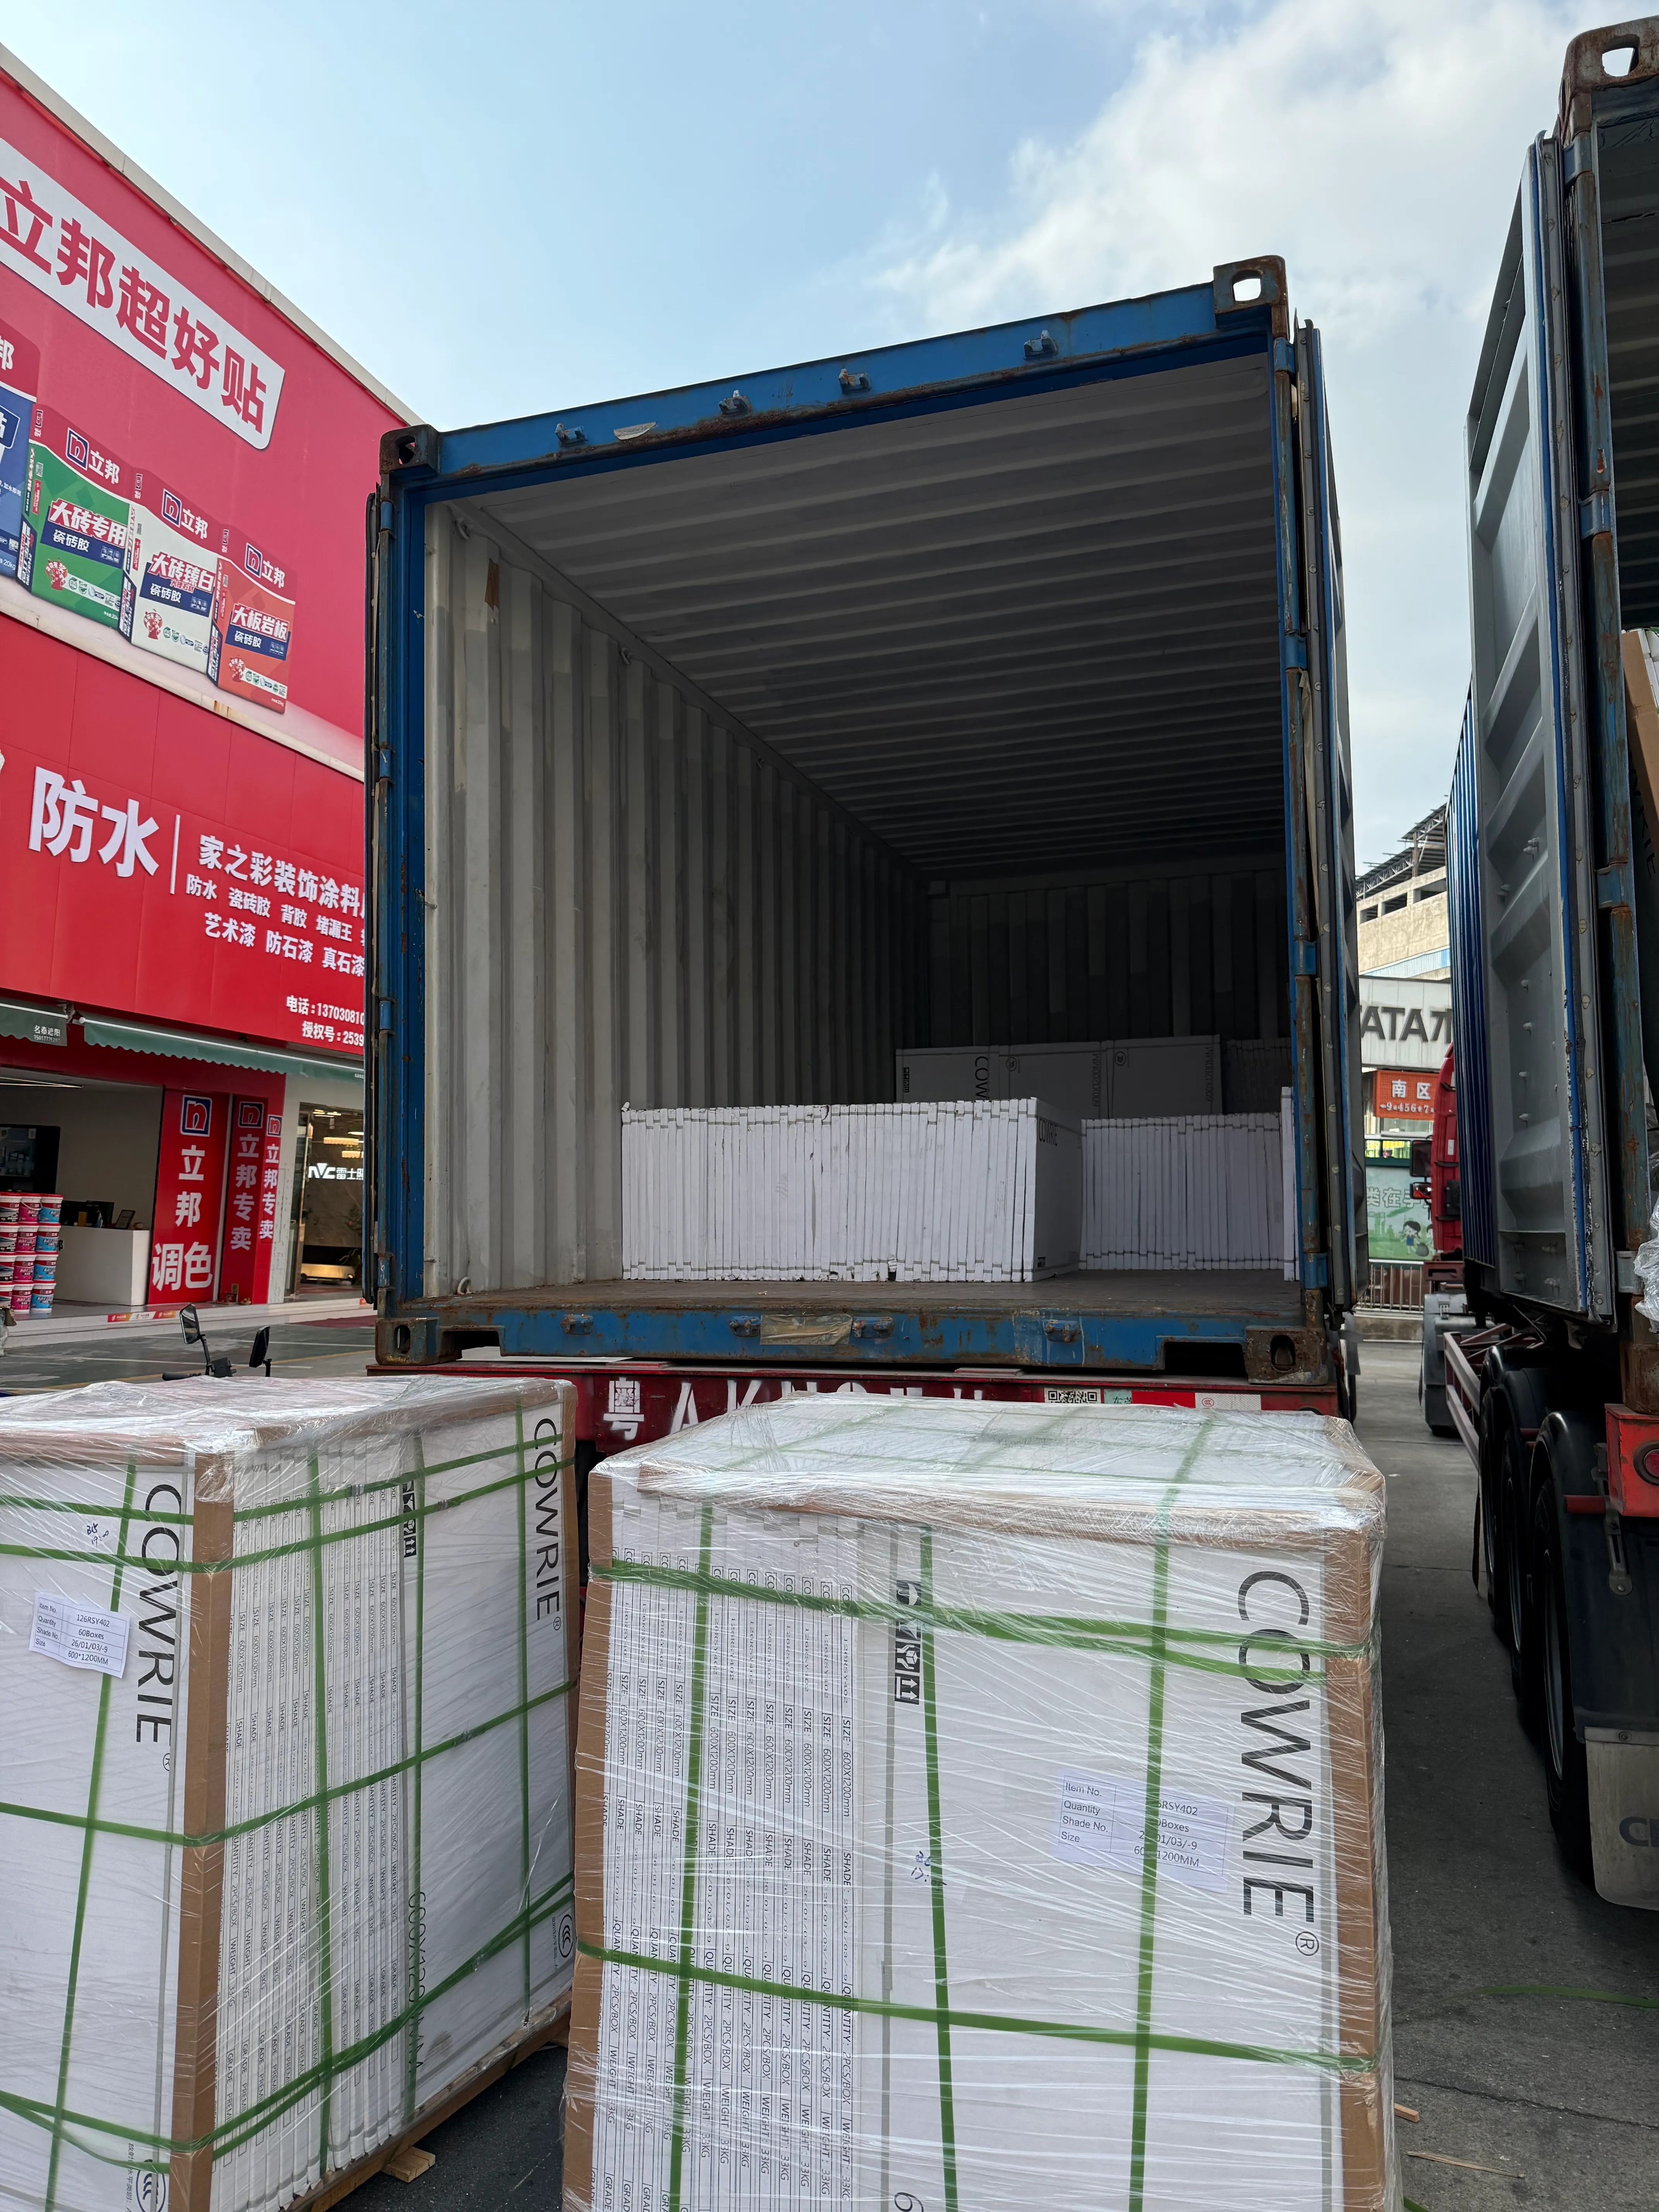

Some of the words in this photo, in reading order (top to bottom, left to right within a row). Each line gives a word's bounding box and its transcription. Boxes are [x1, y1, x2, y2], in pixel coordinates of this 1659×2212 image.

[0, 180, 266, 434] 立邦超好贴
[89, 449, 120, 484] 立邦
[50, 501, 125, 547] 大砖专用
[53, 529, 89, 552] 瓷砖胶
[181, 508, 208, 539] 立邦
[150, 583, 181, 603] 瓷砖胶
[151, 555, 214, 592] 大砖臻白
[261, 560, 285, 588] 立邦
[233, 606, 288, 641] 大板岩板
[234, 630, 262, 648] 瓷砖胶
[29, 766, 159, 878] 防水
[199, 835, 364, 919] 家之彩装饰涂料
[186, 874, 217, 900] 防水
[228, 887, 271, 917] 瓷砖胶
[281, 904, 307, 929] 背胶
[316, 915, 352, 942] 堵漏王
[204, 912, 256, 948] 艺术漆
[266, 930, 314, 963] 防石漆
[323, 947, 364, 977] 真石漆
[1391, 1079, 1431, 1100] 南区
[1039, 1118, 1058, 1147] COWRIE
[230, 1134, 259, 1251] 立邦专卖
[259, 1144, 280, 1240] 立邦专卖
[1367, 1186, 1431, 1209] 类在手
[152, 1242, 213, 1292] 调色
[37, 1627, 51, 1637] Shade
[71, 1639, 108, 1653] 26/01/03/-9
[38, 1615, 56, 1628] Quantity
[78, 1629, 104, 1640] 60Boxes
[40, 1603, 48, 1611] Item
[77, 1614, 110, 1627] 126RSY402
[35, 1638, 46, 1647] Size
[236, 1640, 245, 1693] 600X1200mm
[619, 1704, 628, 1765] 600X1200mm
[637, 1709, 646, 1770] 600X1200mm
[656, 1711, 665, 1772] 600X1200mm
[674, 1714, 682, 1776] 600X1200mm
[709, 1726, 718, 1789] 600X1200mm
[1237, 1571, 1315, 1923] COWRIE
[726, 1731, 736, 1794] 600X1200mm
[746, 1732, 754, 1795] 600X1200mm
[765, 1735, 774, 1799] 600X1200mm
[785, 1739, 793, 1803] 600X1200mm
[843, 1752, 851, 1817] 600X1200mm
[1064, 1800, 1101, 1815] Quantity
[1065, 1782, 1084, 1794] Item
[1087, 1786, 1102, 1796] No.
[1061, 1831, 1080, 1843] Size
[1062, 1815, 1091, 1828] Shade
[1093, 1822, 1108, 1832] No.
[611, 1984, 619, 2033] 2PCS/BOX
[629, 1990, 638, 2040] 2PCS/BOX
[648, 1992, 657, 2042] 2PCS/BOX
[666, 1998, 675, 2049] 2PCS/BOX
[703, 2014, 713, 2064] 2PCS/BOX
[722, 2020, 732, 2070] 2PCS/BOX
[742, 2022, 751, 2074] 2PCS/BOX
[762, 2028, 771, 2079] 2PCS/BOX
[781, 2033, 791, 2085] 2PCS/BOX
[802, 2039, 811, 2091] 2PCS/BOX
[822, 2046, 831, 2098] 2PCS/BOX
[842, 2052, 851, 2105] 2PCS/BOX
[701, 2133, 710, 2158] 33KG
[720, 2139, 729, 2164] 33KG
[741, 2142, 750, 2168] 33KG
[761, 2149, 769, 2174] 33KG
[780, 2155, 789, 2181] 33KG
[800, 2161, 809, 2188] 33KG
[821, 2169, 830, 2195] 33KG
[842, 2175, 850, 2202] 33KG
